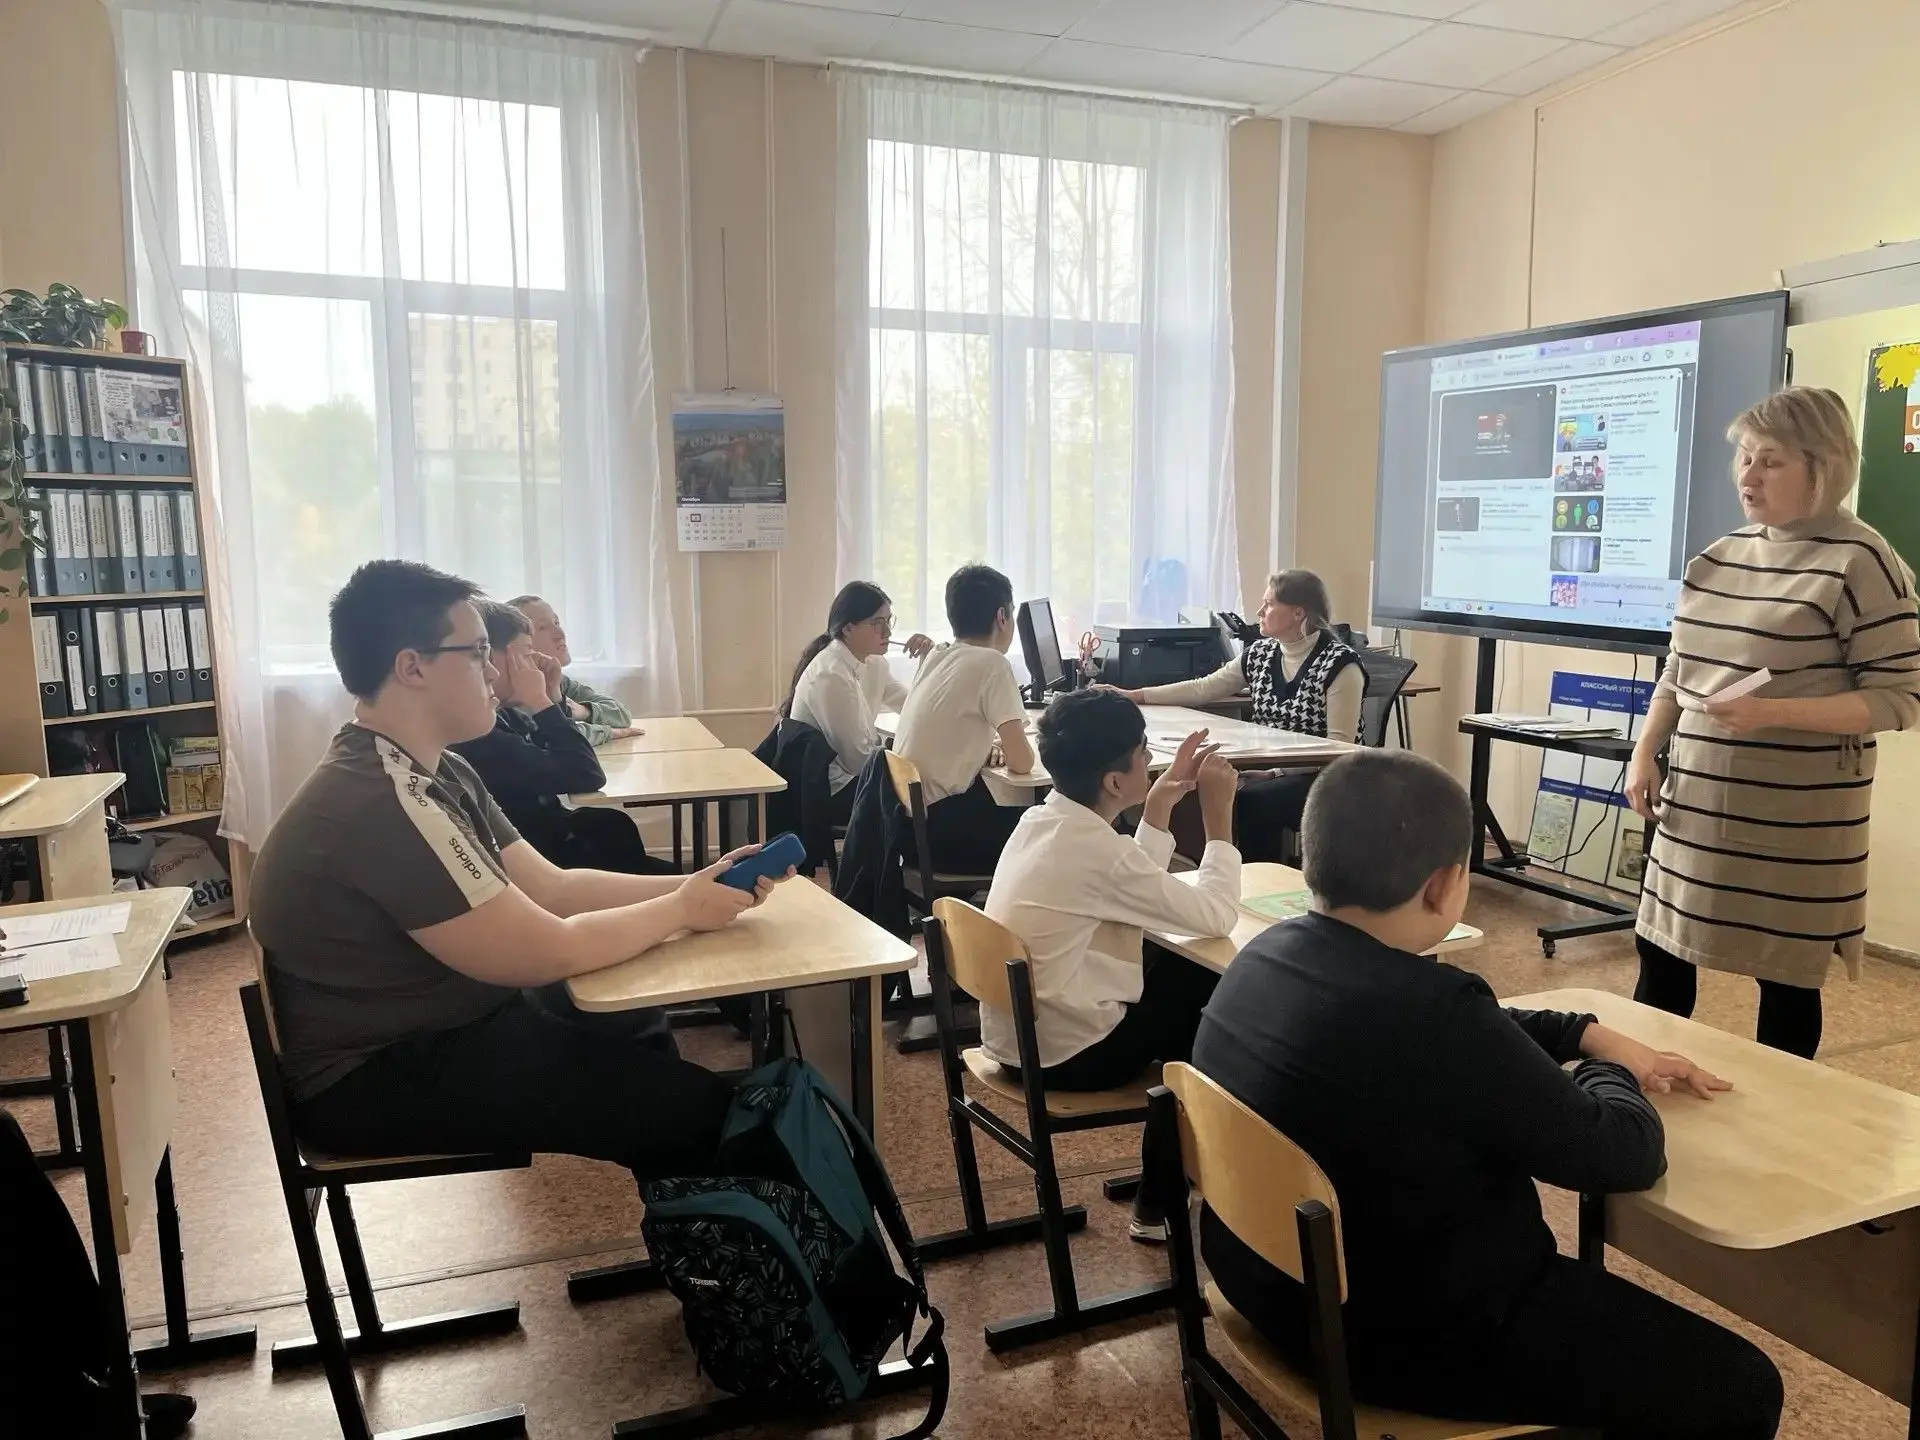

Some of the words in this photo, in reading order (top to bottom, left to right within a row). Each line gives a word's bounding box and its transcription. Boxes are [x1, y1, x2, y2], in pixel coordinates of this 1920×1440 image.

[1580, 681, 1618, 692] КЛАССНЫЙ
[408, 775, 428, 807] adida
[448, 837, 482, 881] adidas
